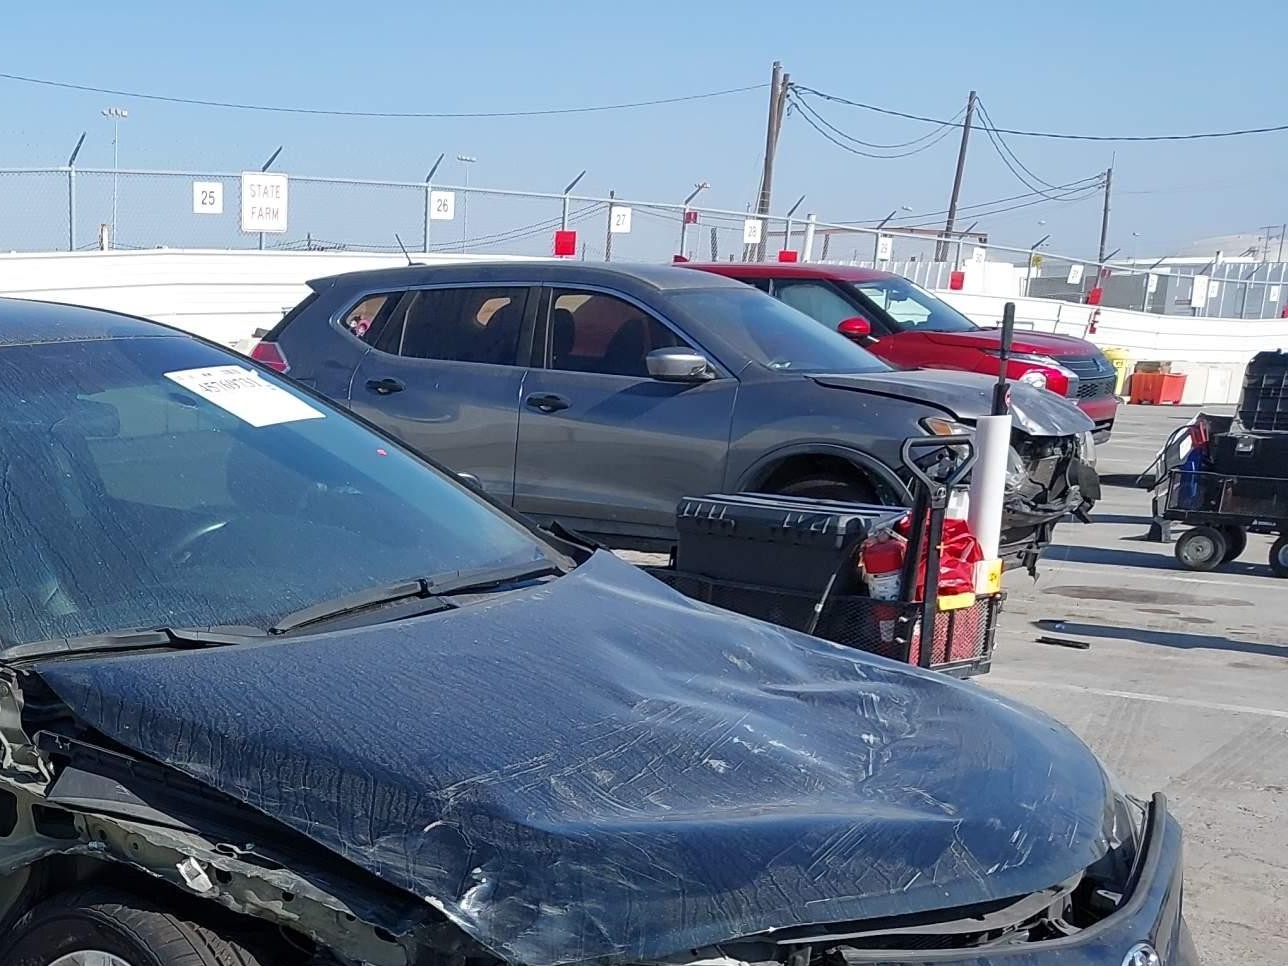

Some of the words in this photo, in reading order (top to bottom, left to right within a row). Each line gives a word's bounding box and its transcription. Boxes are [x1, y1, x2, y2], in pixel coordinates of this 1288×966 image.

[201, 190, 216, 206] 25
[249, 183, 281, 199] STATE
[436, 198, 449, 212] 26
[251, 206, 279, 221] FARM
[615, 214, 626, 226] 27
